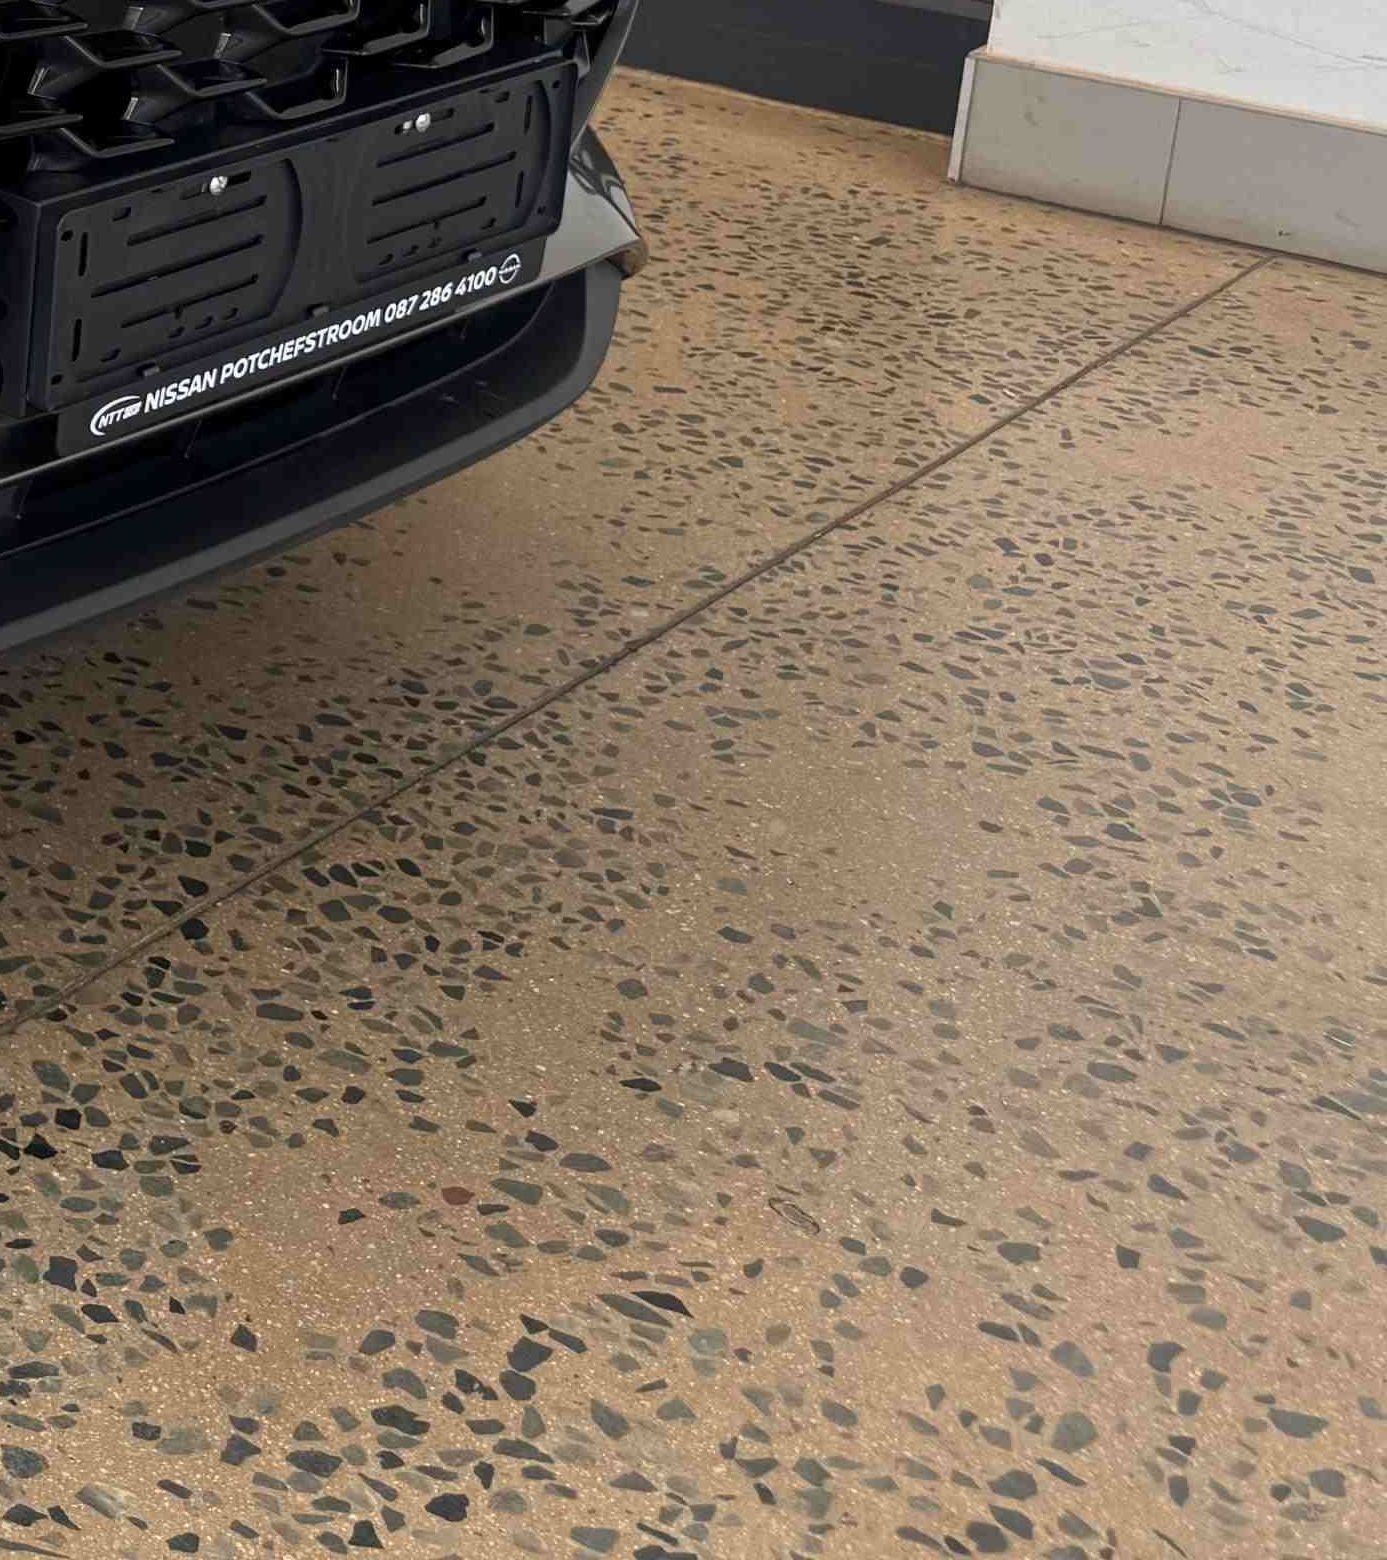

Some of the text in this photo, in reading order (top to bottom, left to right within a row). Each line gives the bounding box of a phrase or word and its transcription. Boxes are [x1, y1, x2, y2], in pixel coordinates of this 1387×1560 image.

[144, 368, 217, 413] NISSAN
[220, 308, 381, 384] POTCHEFSTROOM
[384, 295, 419, 324] 087
[418, 282, 454, 311] 286
[455, 266, 497, 296] 4100
